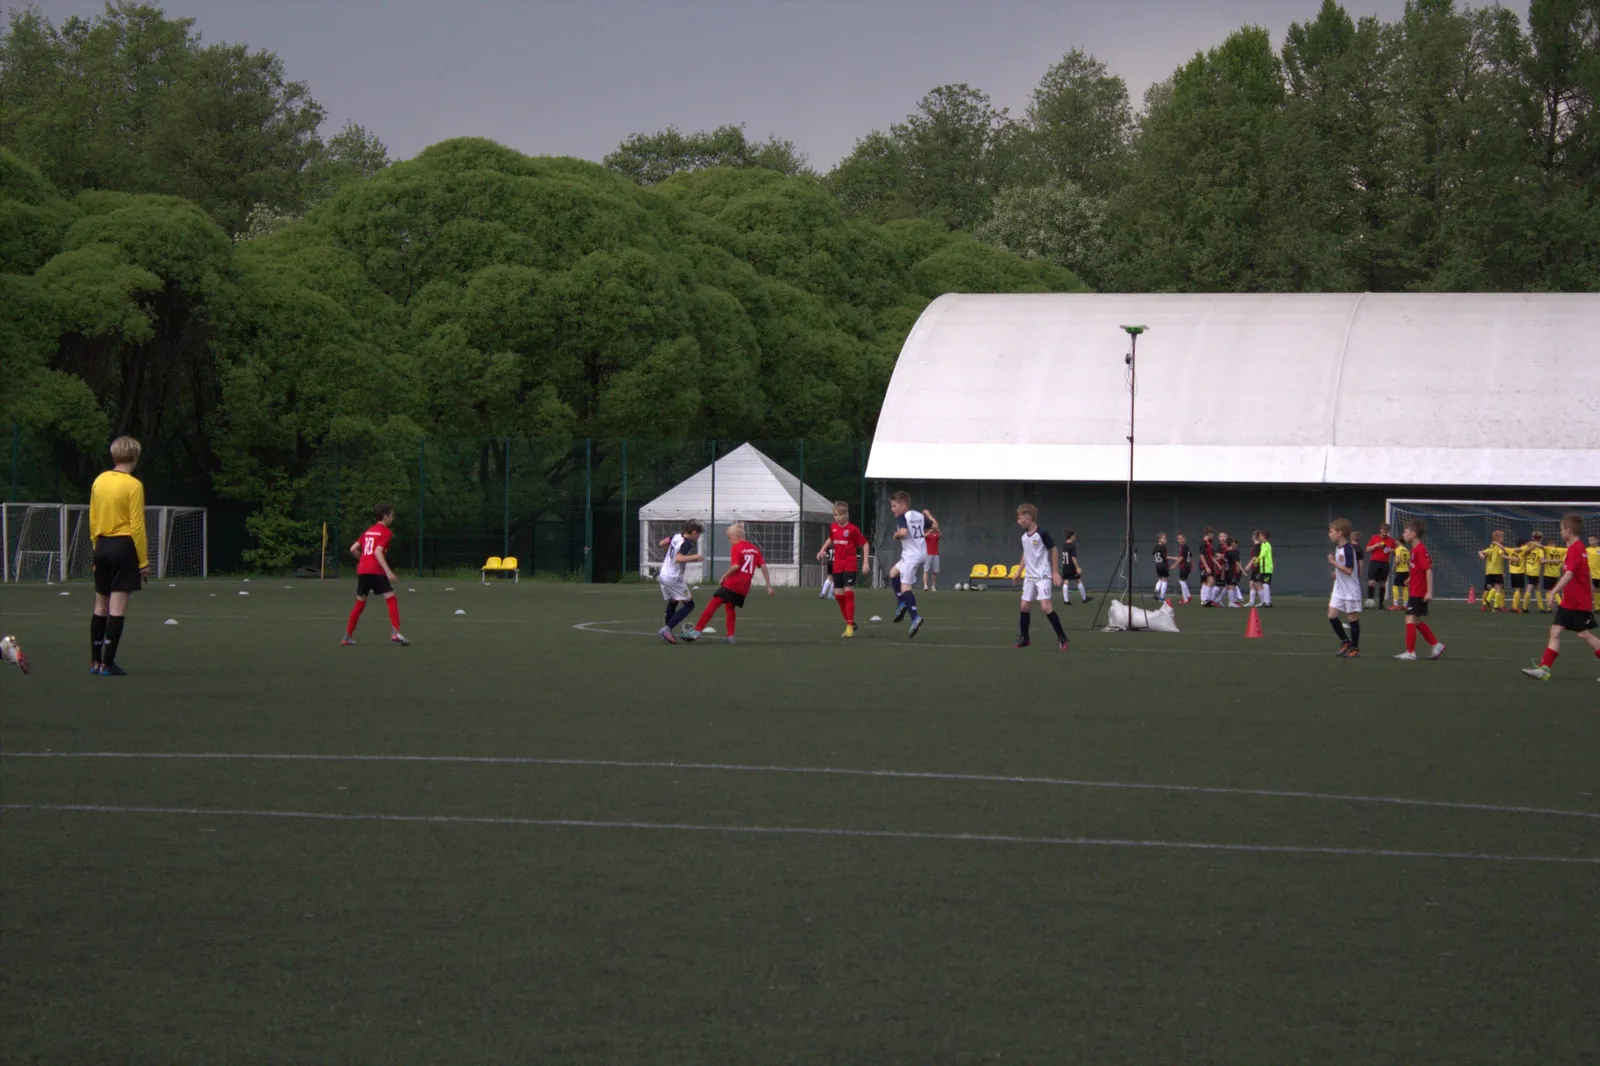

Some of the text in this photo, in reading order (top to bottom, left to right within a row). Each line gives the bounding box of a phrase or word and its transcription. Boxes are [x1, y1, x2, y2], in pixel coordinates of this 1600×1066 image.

[912, 525, 925, 539] 21
[364, 537, 375, 555] 10
[741, 554, 754, 574] 21
